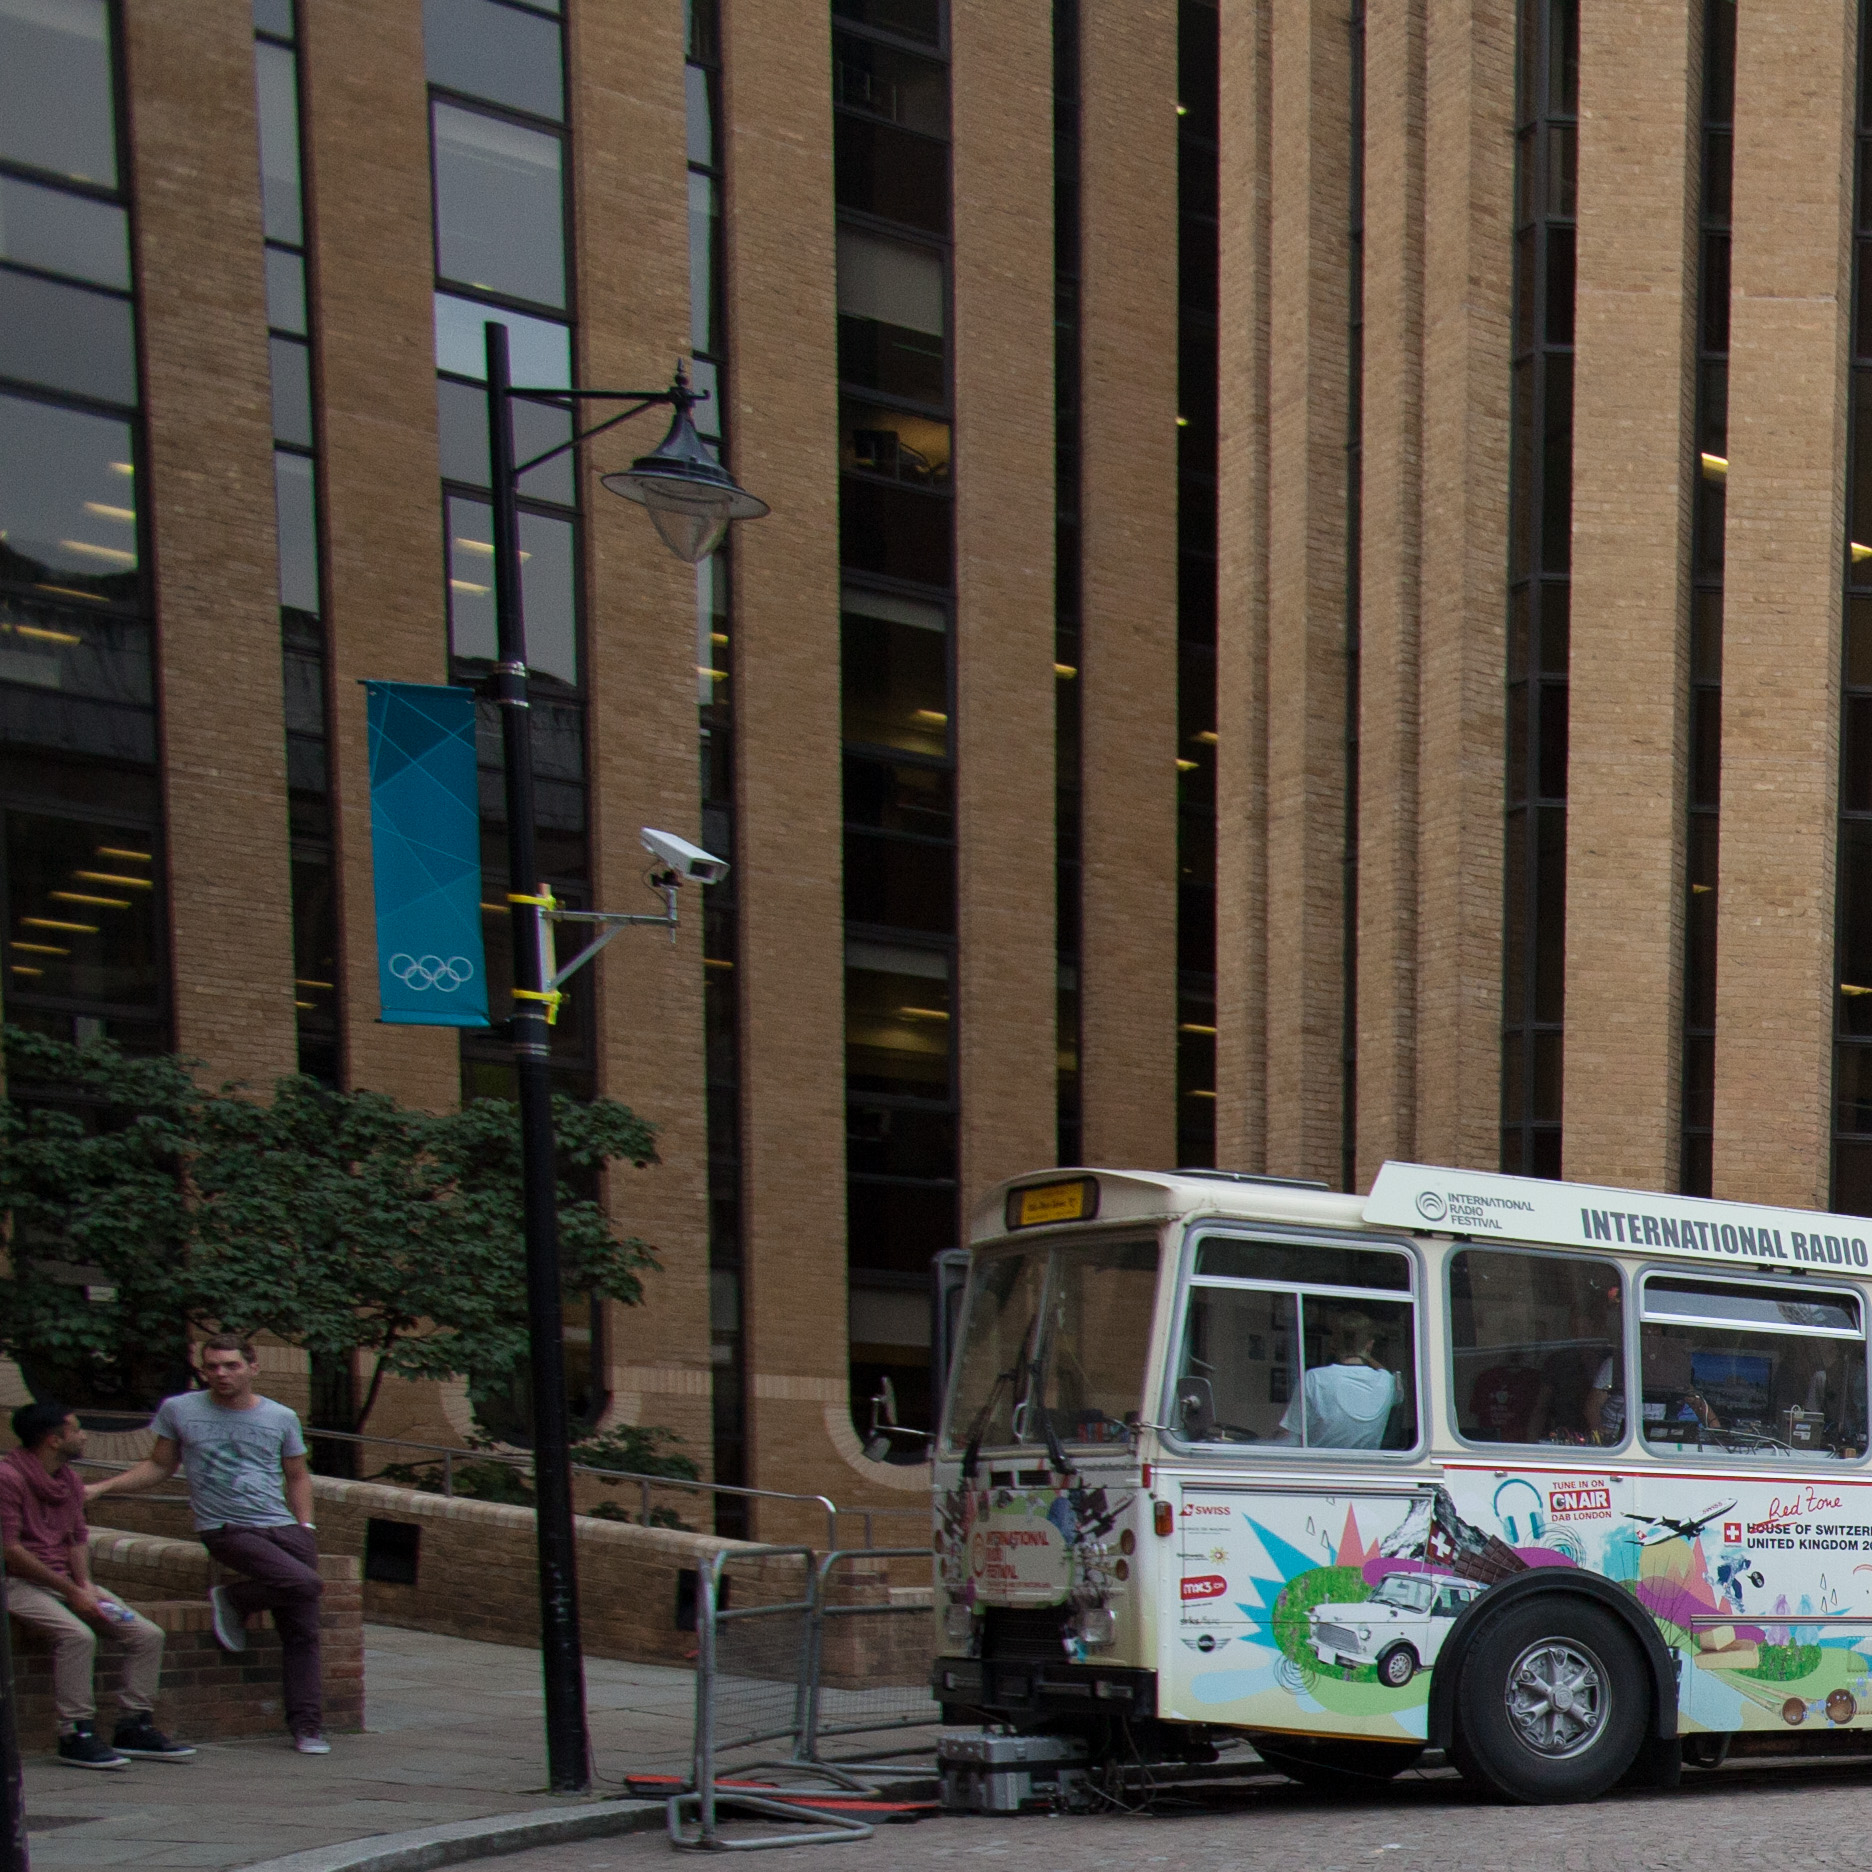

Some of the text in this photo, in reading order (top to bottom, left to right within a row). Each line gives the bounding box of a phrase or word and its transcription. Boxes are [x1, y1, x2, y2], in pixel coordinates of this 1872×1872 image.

[1448, 1192, 1535, 1212] INTERNATIONAL
[1450, 1204, 1483, 1216] RADIO
[1451, 1215, 1502, 1229] FESTIVAL
[1581, 1208, 1788, 1259] INTERNATIONAL
[1791, 1231, 1869, 1267] RADIO
[1553, 1479, 1605, 1489] TUNE IN ON
[1579, 1491, 1608, 1508] AIR
[1195, 1505, 1231, 1516] SWISS
[1769, 1495, 1803, 1519] Red
[1552, 1511, 1612, 1522] DAB LONDON
[1747, 1522, 1791, 1535] HOUSE
[1795, 1524, 1811, 1535] OF
[1747, 1537, 1795, 1550] UNITED
[1799, 1538, 1859, 1551] KINGDOM
